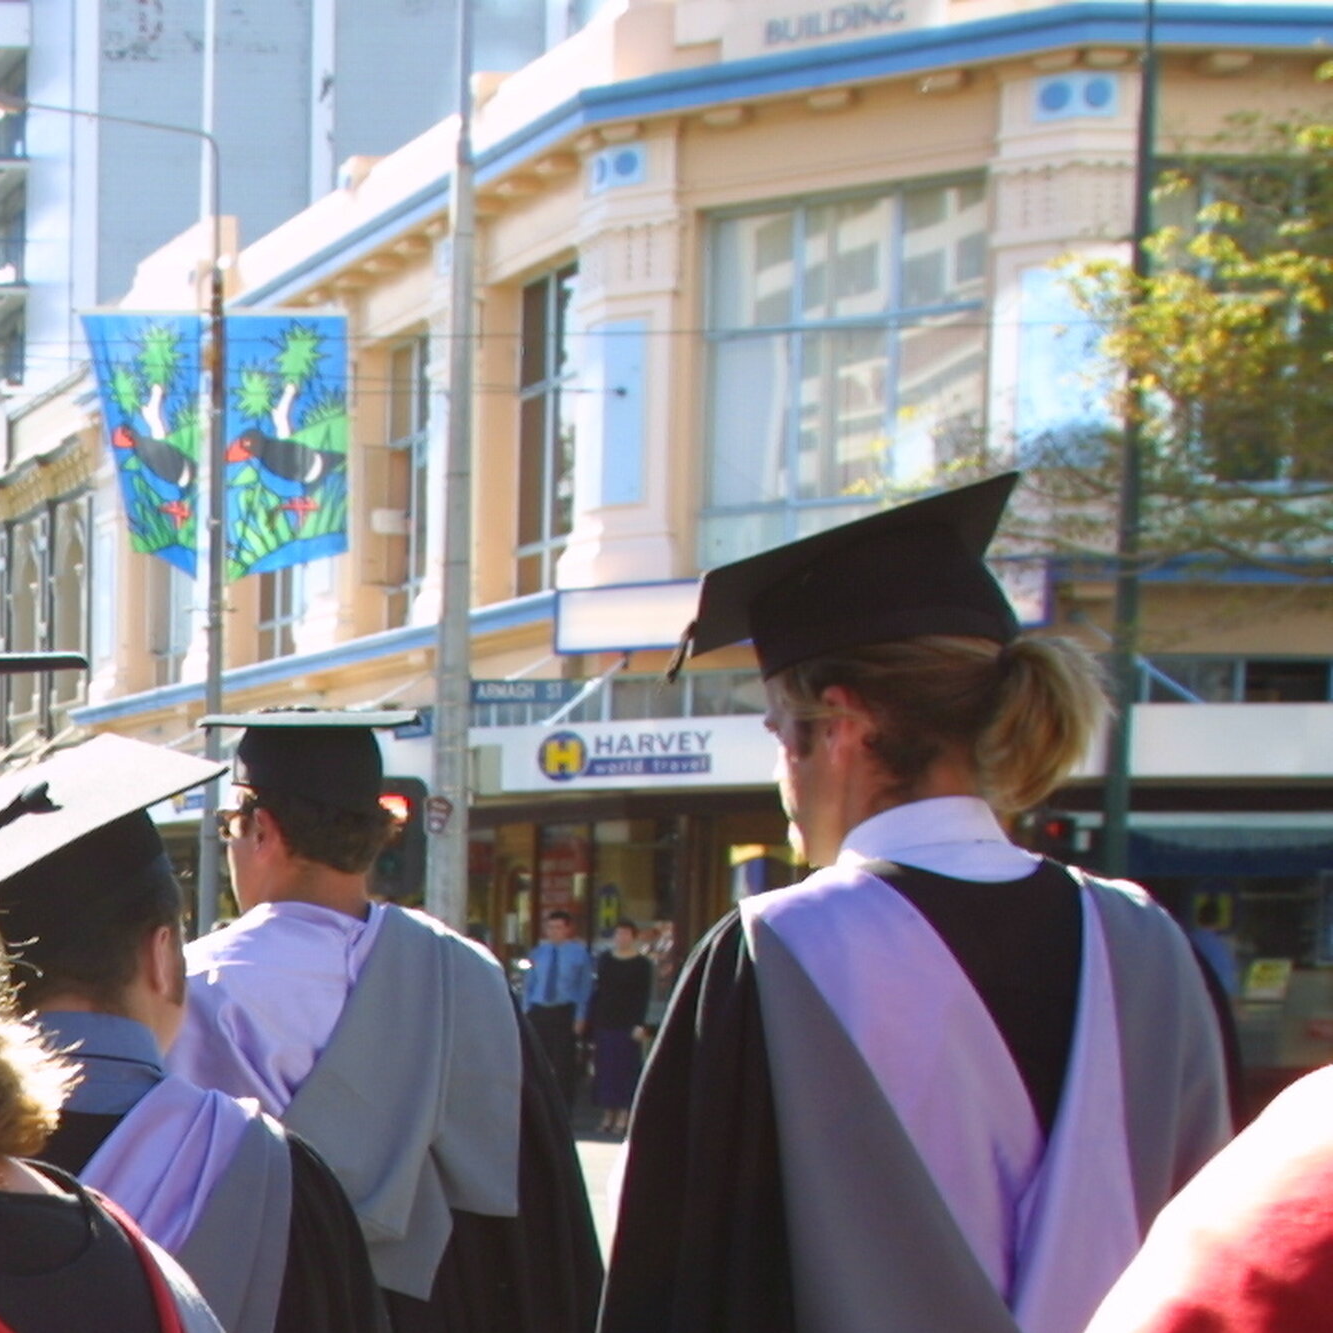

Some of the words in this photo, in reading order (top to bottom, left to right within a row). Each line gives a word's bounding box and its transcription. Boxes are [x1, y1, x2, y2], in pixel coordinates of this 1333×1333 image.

[595, 732, 711, 754] HARVEY
[594, 758, 643, 773] world
[653, 756, 709, 771] travel
